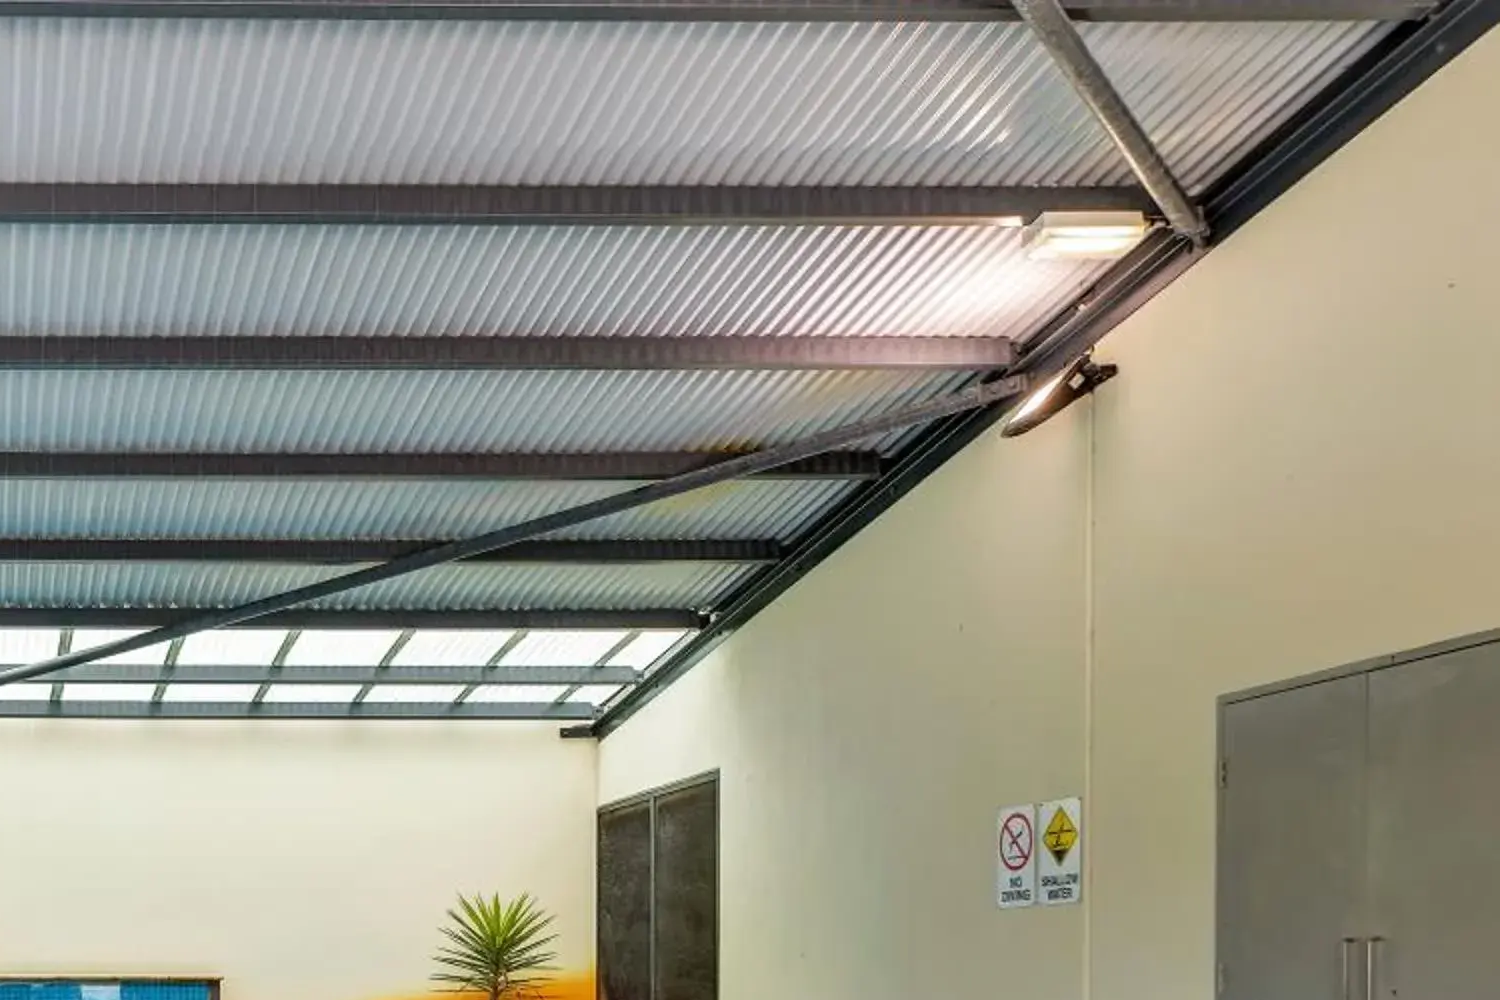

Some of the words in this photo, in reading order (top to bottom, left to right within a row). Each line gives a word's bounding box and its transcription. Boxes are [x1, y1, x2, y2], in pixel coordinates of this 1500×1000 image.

[1009, 877, 1022, 888] NO
[1041, 874, 1078, 887] SHALLOW
[1001, 890, 1031, 902] DIVING
[1047, 887, 1073, 900] WATER
